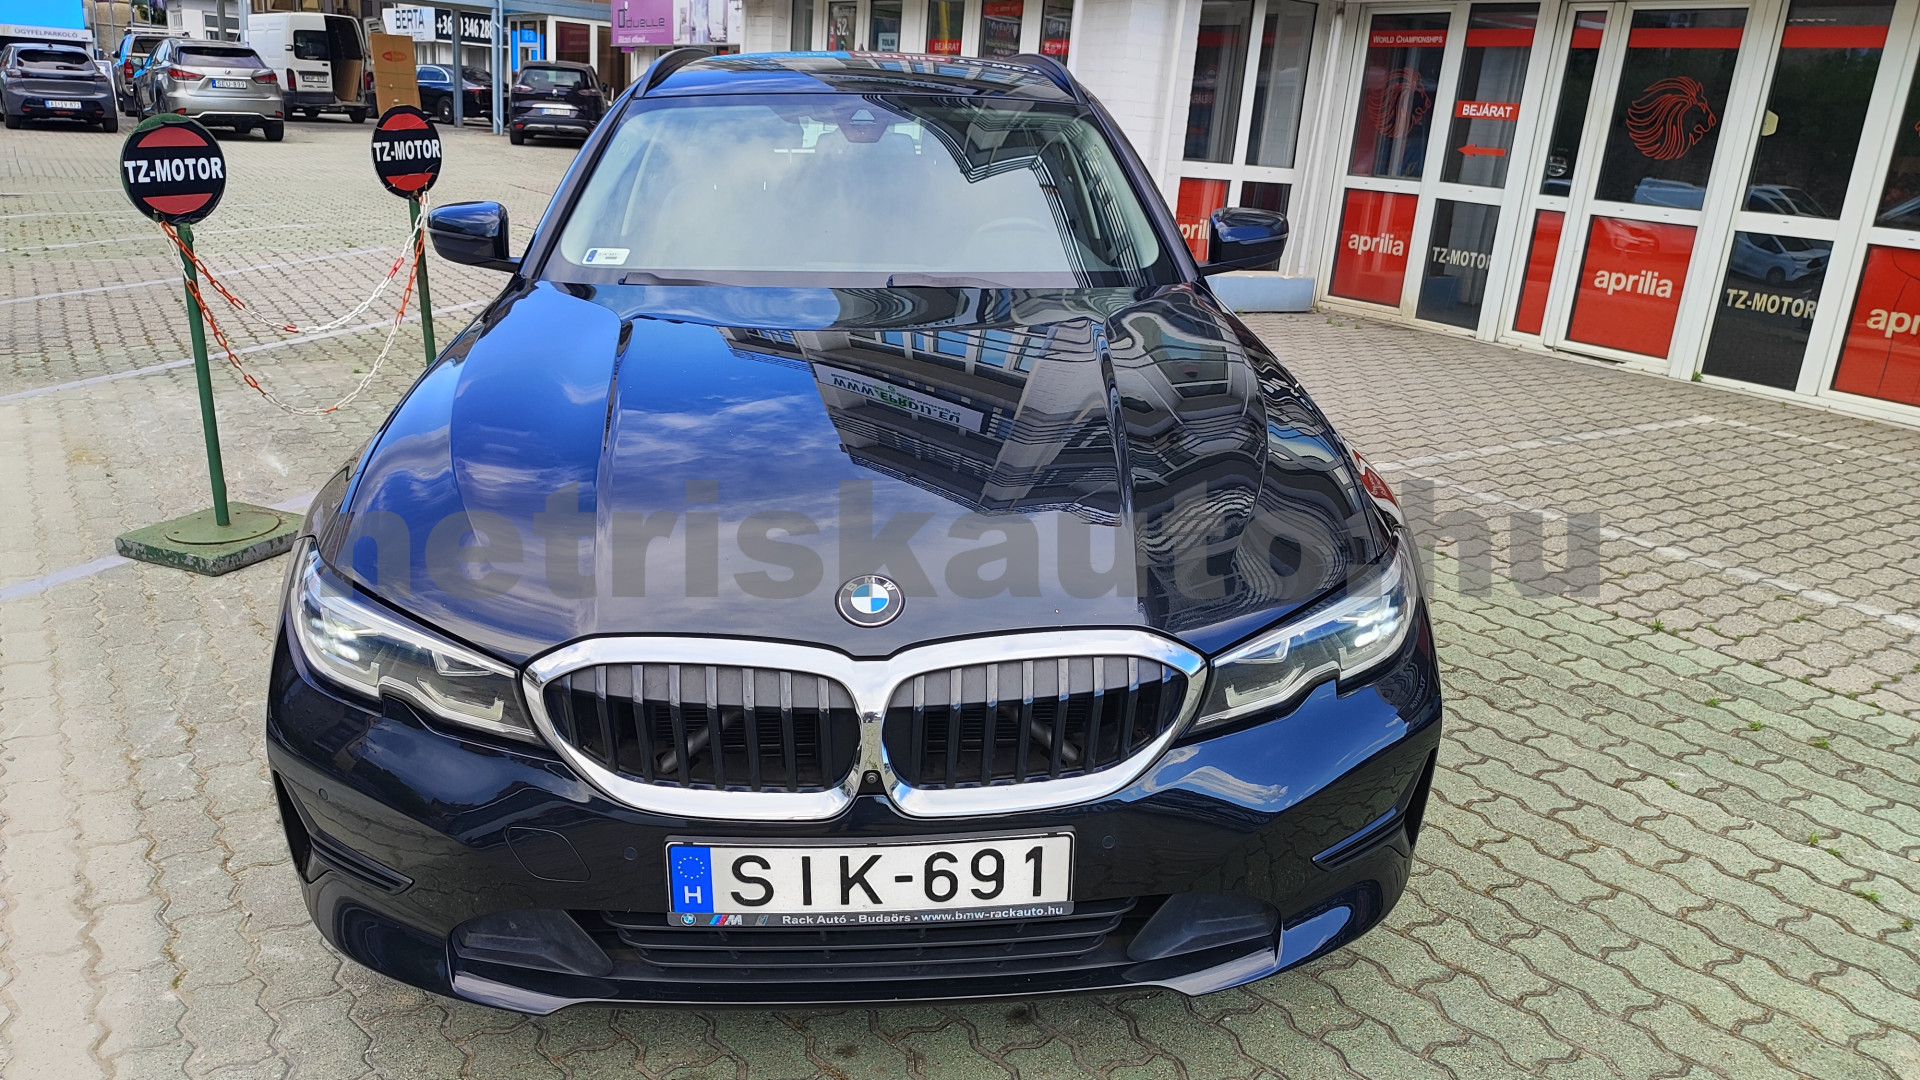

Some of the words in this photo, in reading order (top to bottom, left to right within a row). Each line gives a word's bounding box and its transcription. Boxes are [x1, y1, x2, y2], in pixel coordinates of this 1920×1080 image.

[395, 9, 424, 29] BERTA
[1462, 103, 1513, 117] BEJÁRAT
[373, 139, 441, 162] TZ-MOTOR
[124, 157, 224, 184] TZ-MOTOR
[1180, 218, 1209, 240] pril
[1348, 233, 1404, 256] aprilia
[1593, 269, 1674, 299] aprilia
[1726, 288, 1819, 320] TZ-MOTOR
[1866, 308, 1920, 338] apr
[845, 576, 896, 592] BMW
[730, 845, 1044, 907] SIK-691
[684, 886, 702, 905] H
[782, 915, 814, 925] Rack
[816, 914, 847, 925] Autó
[858, 912, 912, 924] Budaörs
[920, 905, 1064, 922] www.bmw-rackauto.hu
